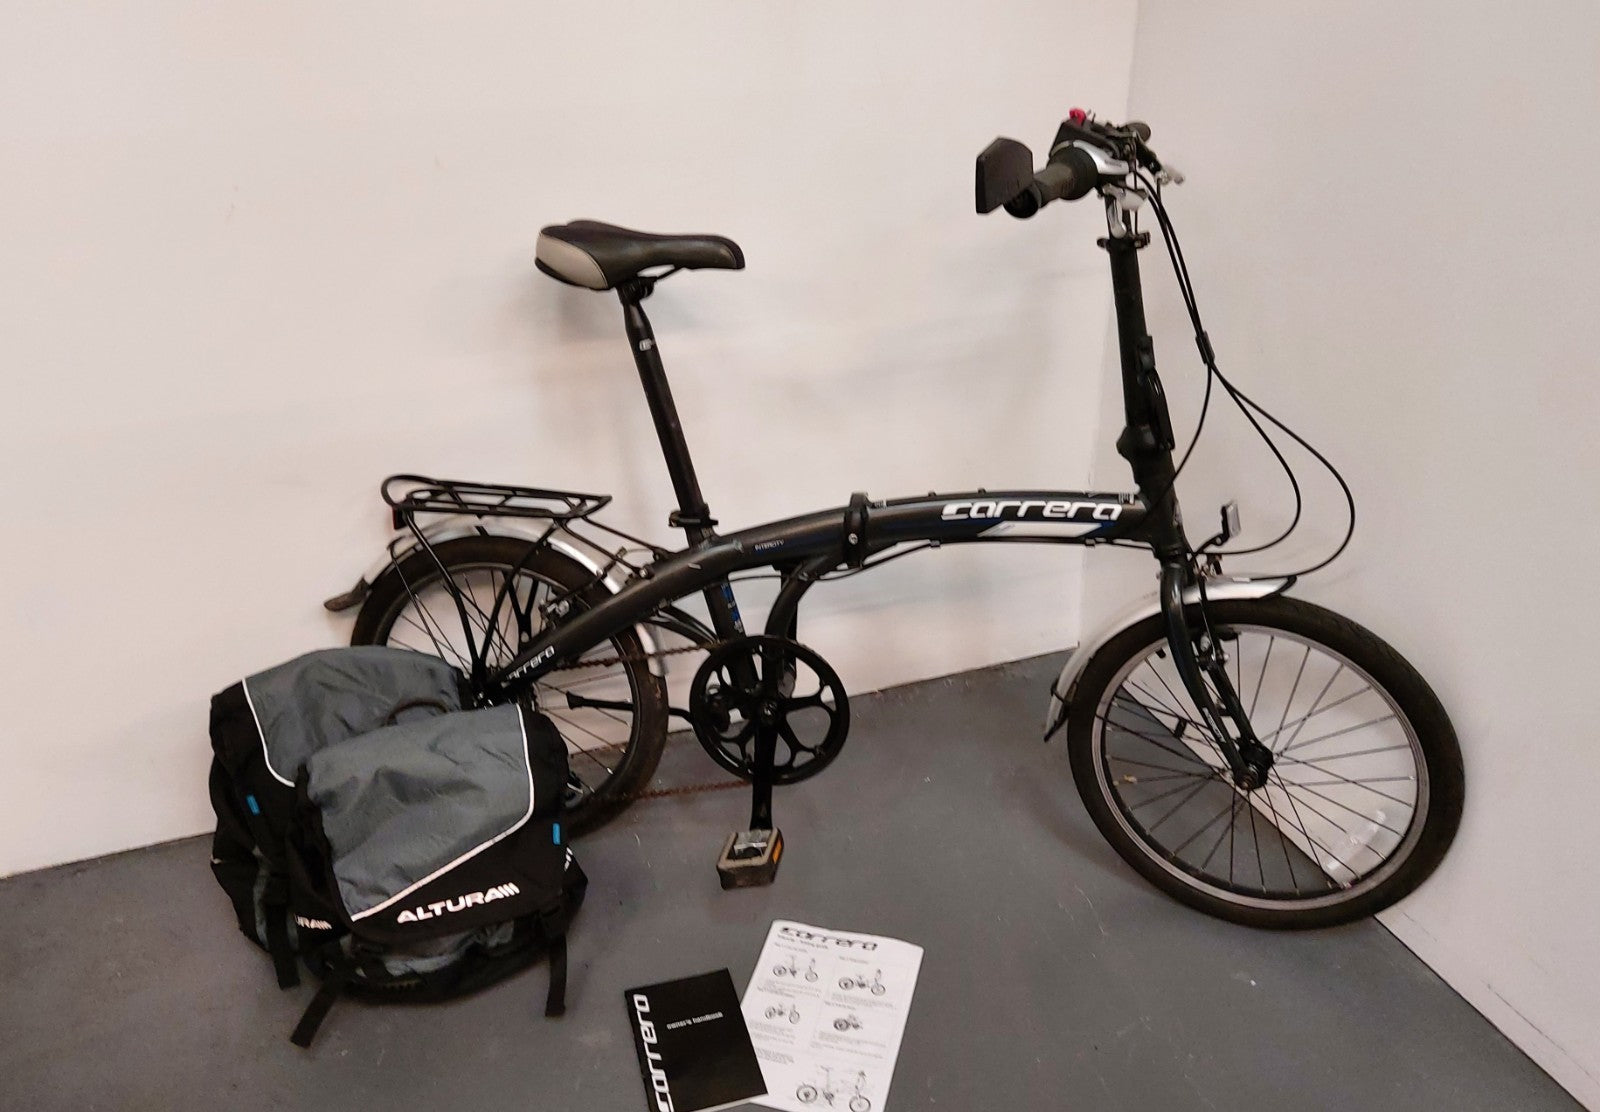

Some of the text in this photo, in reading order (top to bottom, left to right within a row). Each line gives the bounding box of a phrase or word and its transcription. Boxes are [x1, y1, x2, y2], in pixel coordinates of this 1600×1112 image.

[941, 501, 1122, 521] carrera
[507, 645, 555, 680] arrera
[780, 927, 878, 951] carrera
[633, 993, 675, 1112] carrera
